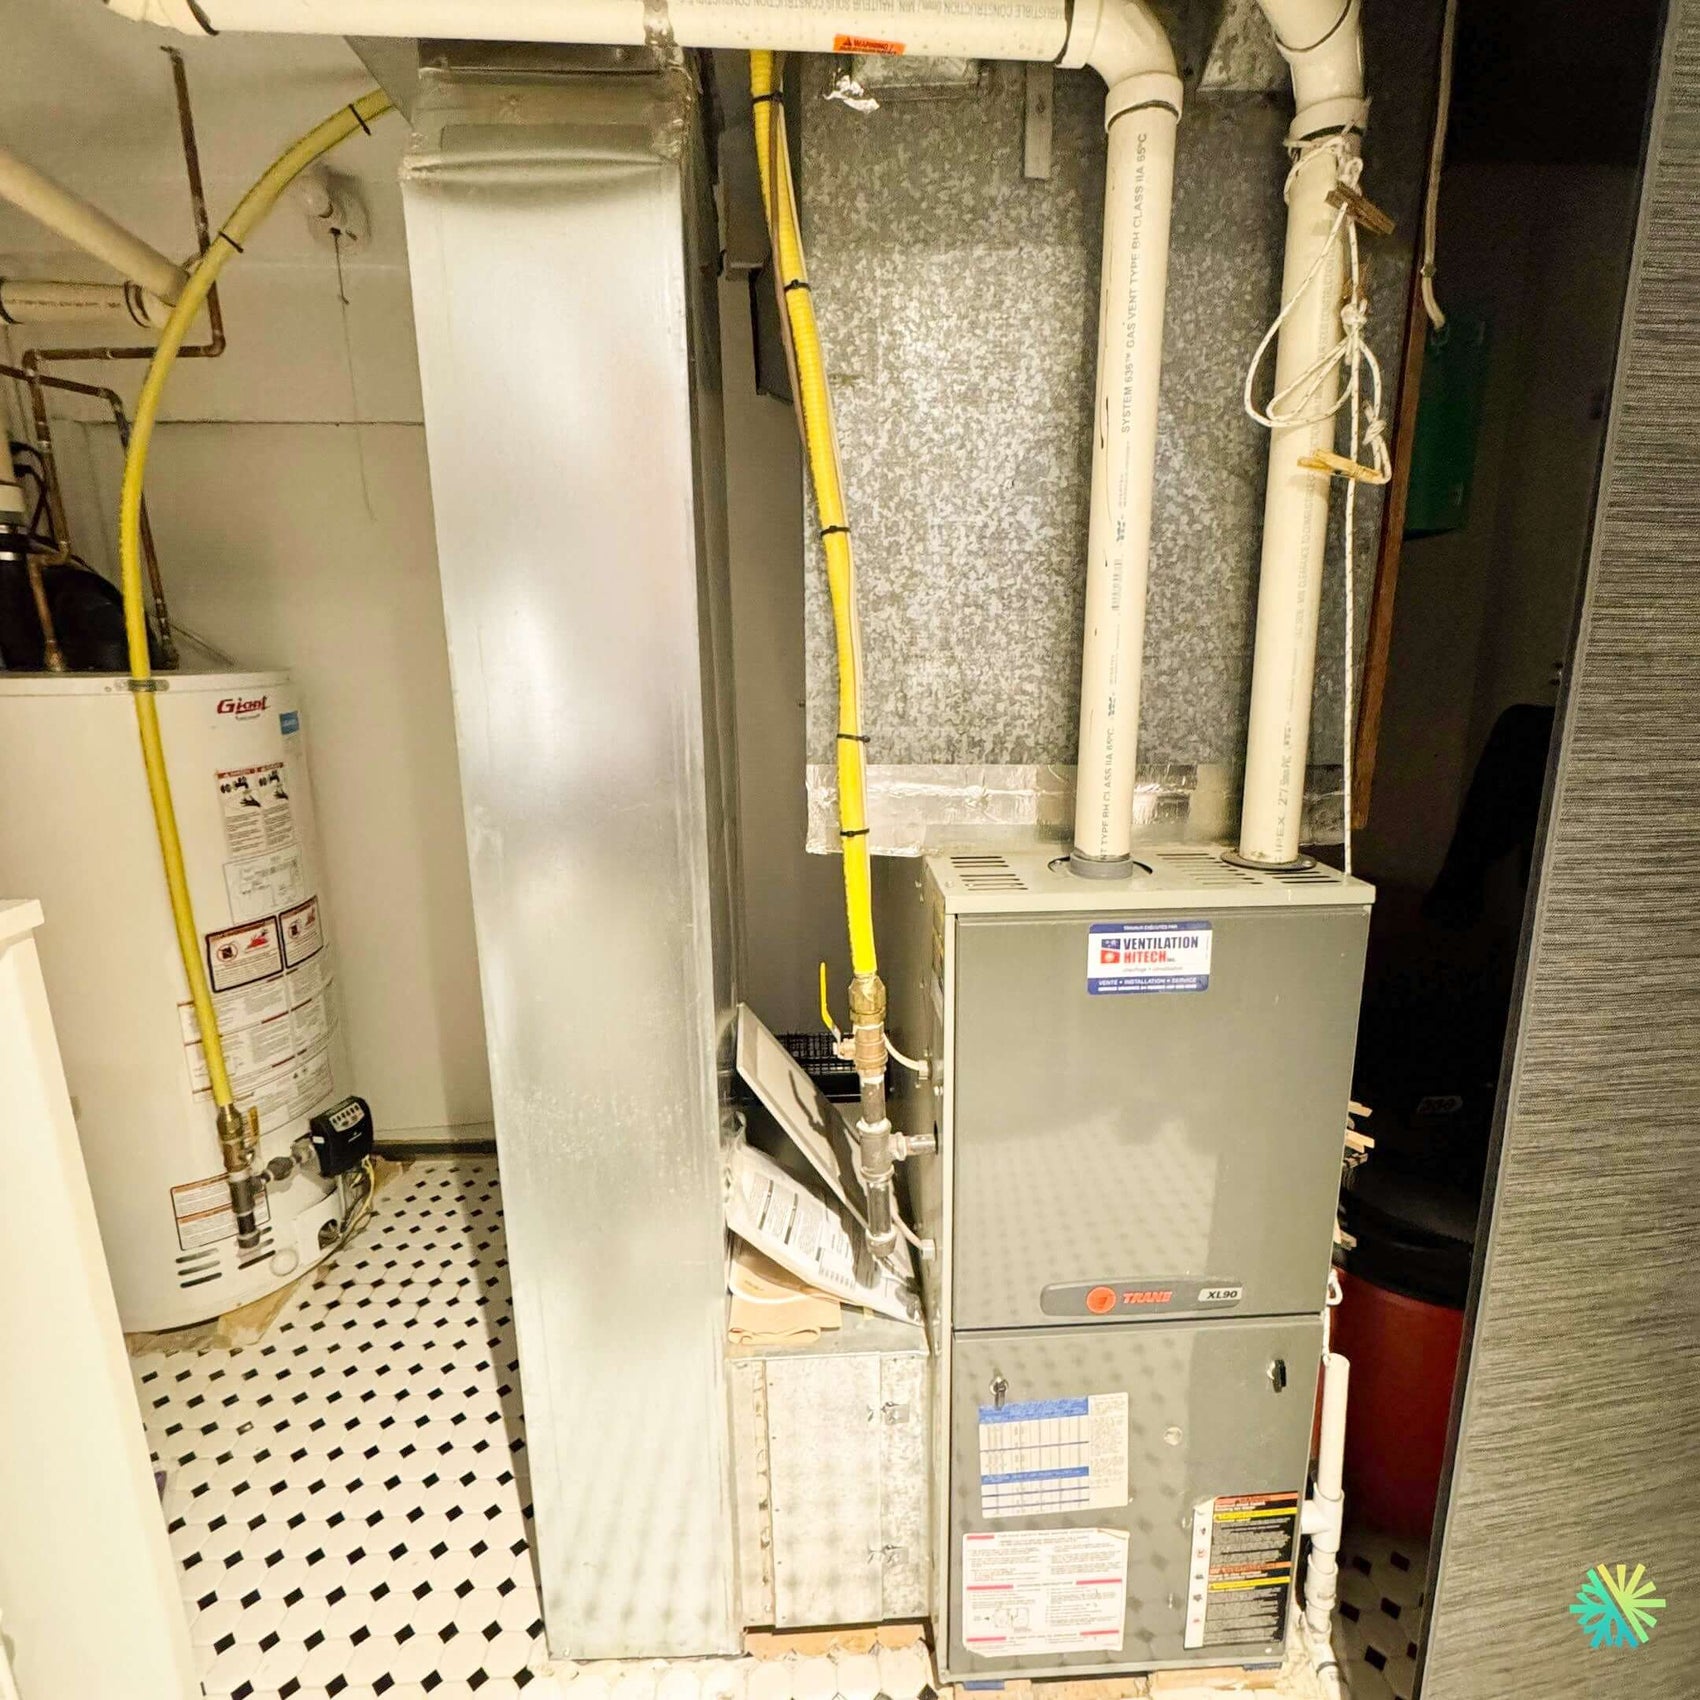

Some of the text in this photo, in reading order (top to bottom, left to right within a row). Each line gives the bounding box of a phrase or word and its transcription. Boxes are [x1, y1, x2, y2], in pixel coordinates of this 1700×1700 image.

[1132, 184, 1144, 229] CLASS
[1132, 232, 1141, 249] BH
[1129, 253, 1140, 285] TYPE
[1128, 288, 1137, 320] VENT
[1126, 322, 1136, 349] GAS
[1121, 386, 1133, 434] SYSTEM
[217, 695, 270, 714] Giant
[1123, 936, 1199, 950] VENTILATION
[1124, 951, 1167, 964] HITECH
[1123, 1291, 1173, 1304] TRANE
[1207, 1290, 1238, 1300] XL90
